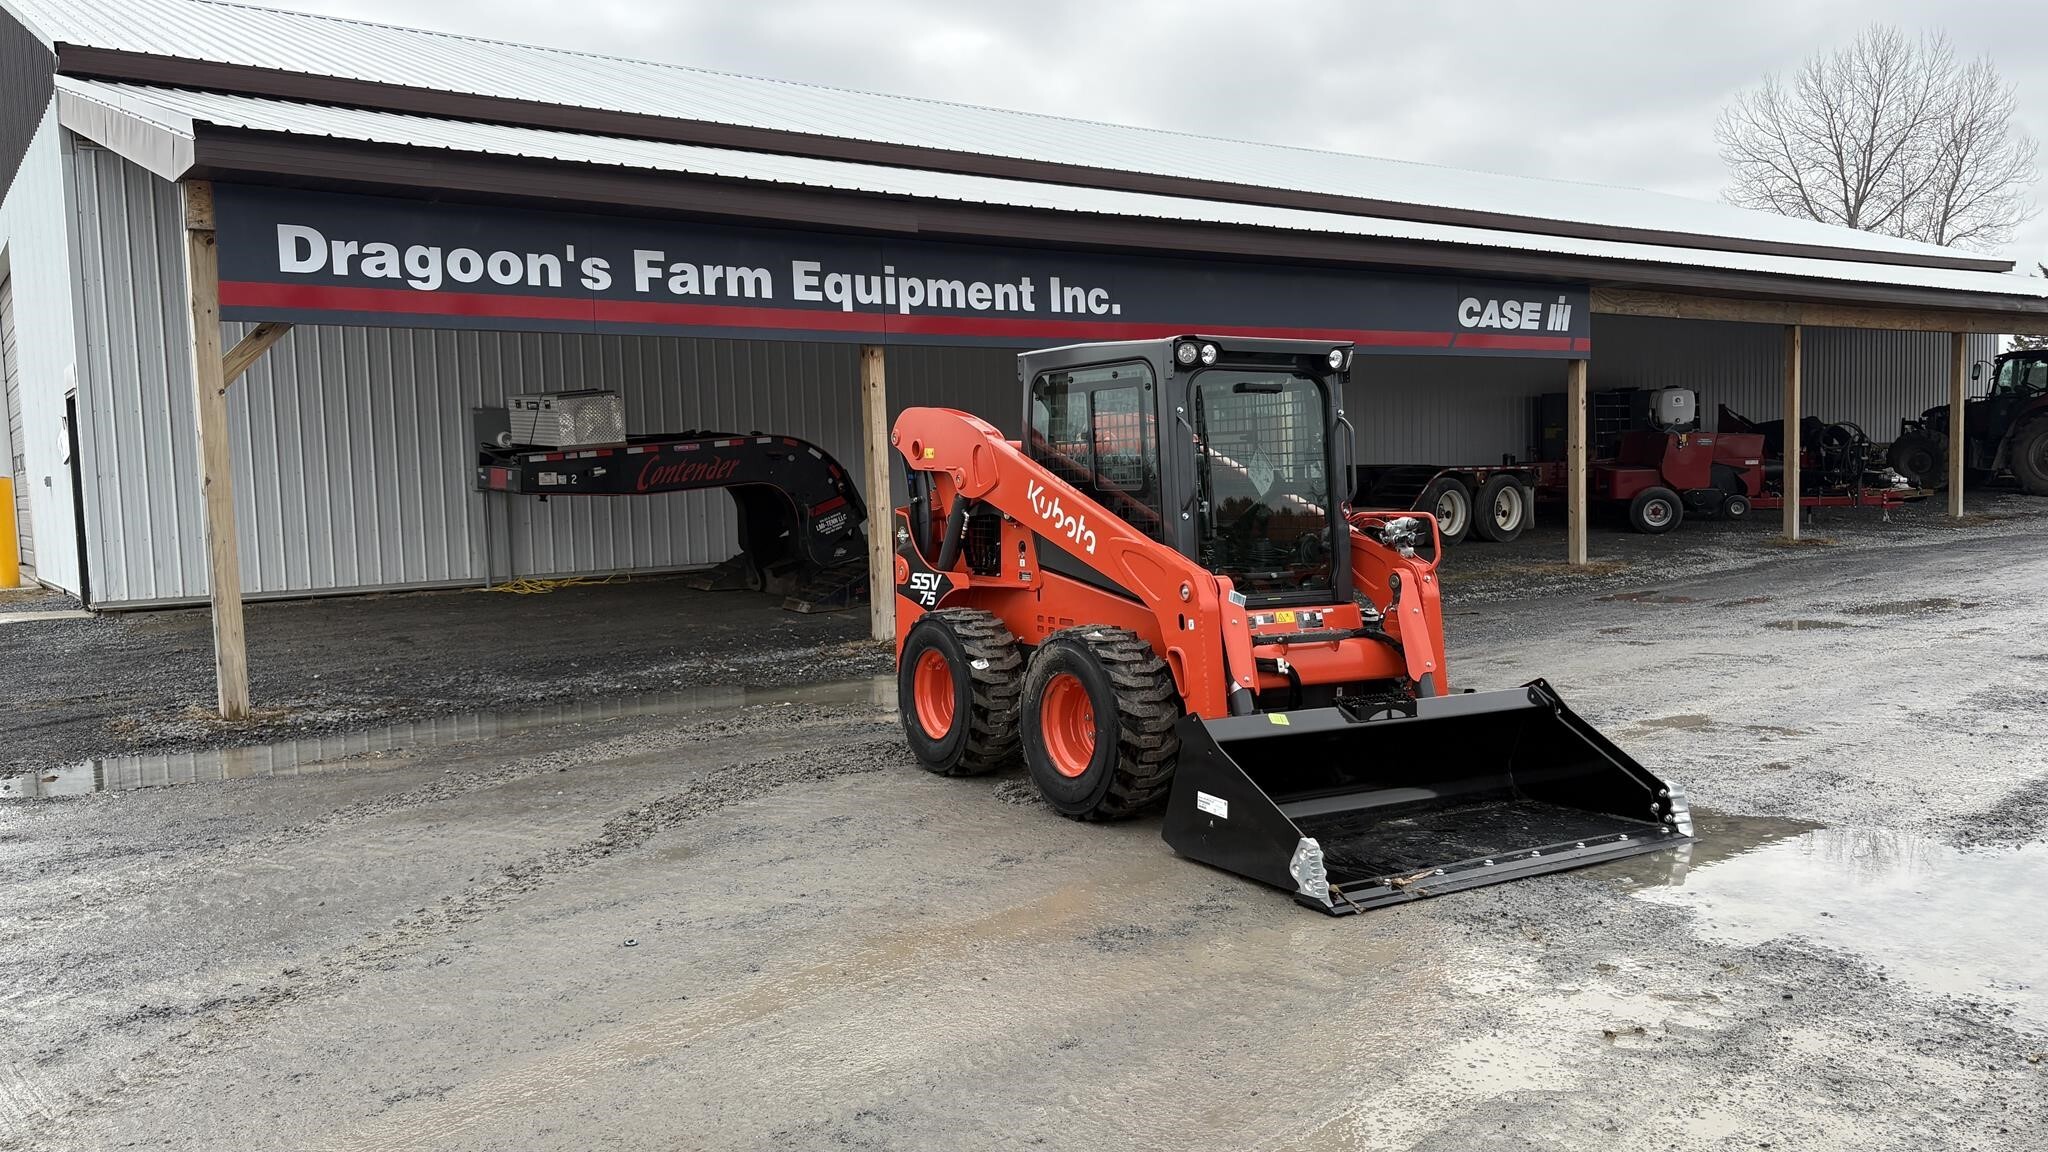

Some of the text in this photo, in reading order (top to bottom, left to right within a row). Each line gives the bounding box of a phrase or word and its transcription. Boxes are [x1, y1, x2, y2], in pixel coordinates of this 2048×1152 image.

[276, 223, 1122, 316] Dragoon's Farm Equipment Inc.
[1458, 297, 1543, 330] CASE
[571, 474, 577, 484] 2
[637, 454, 741, 491] Contender
[1027, 479, 1097, 555] Kubota
[910, 572, 943, 591] SSV
[919, 590, 937, 606] 75
